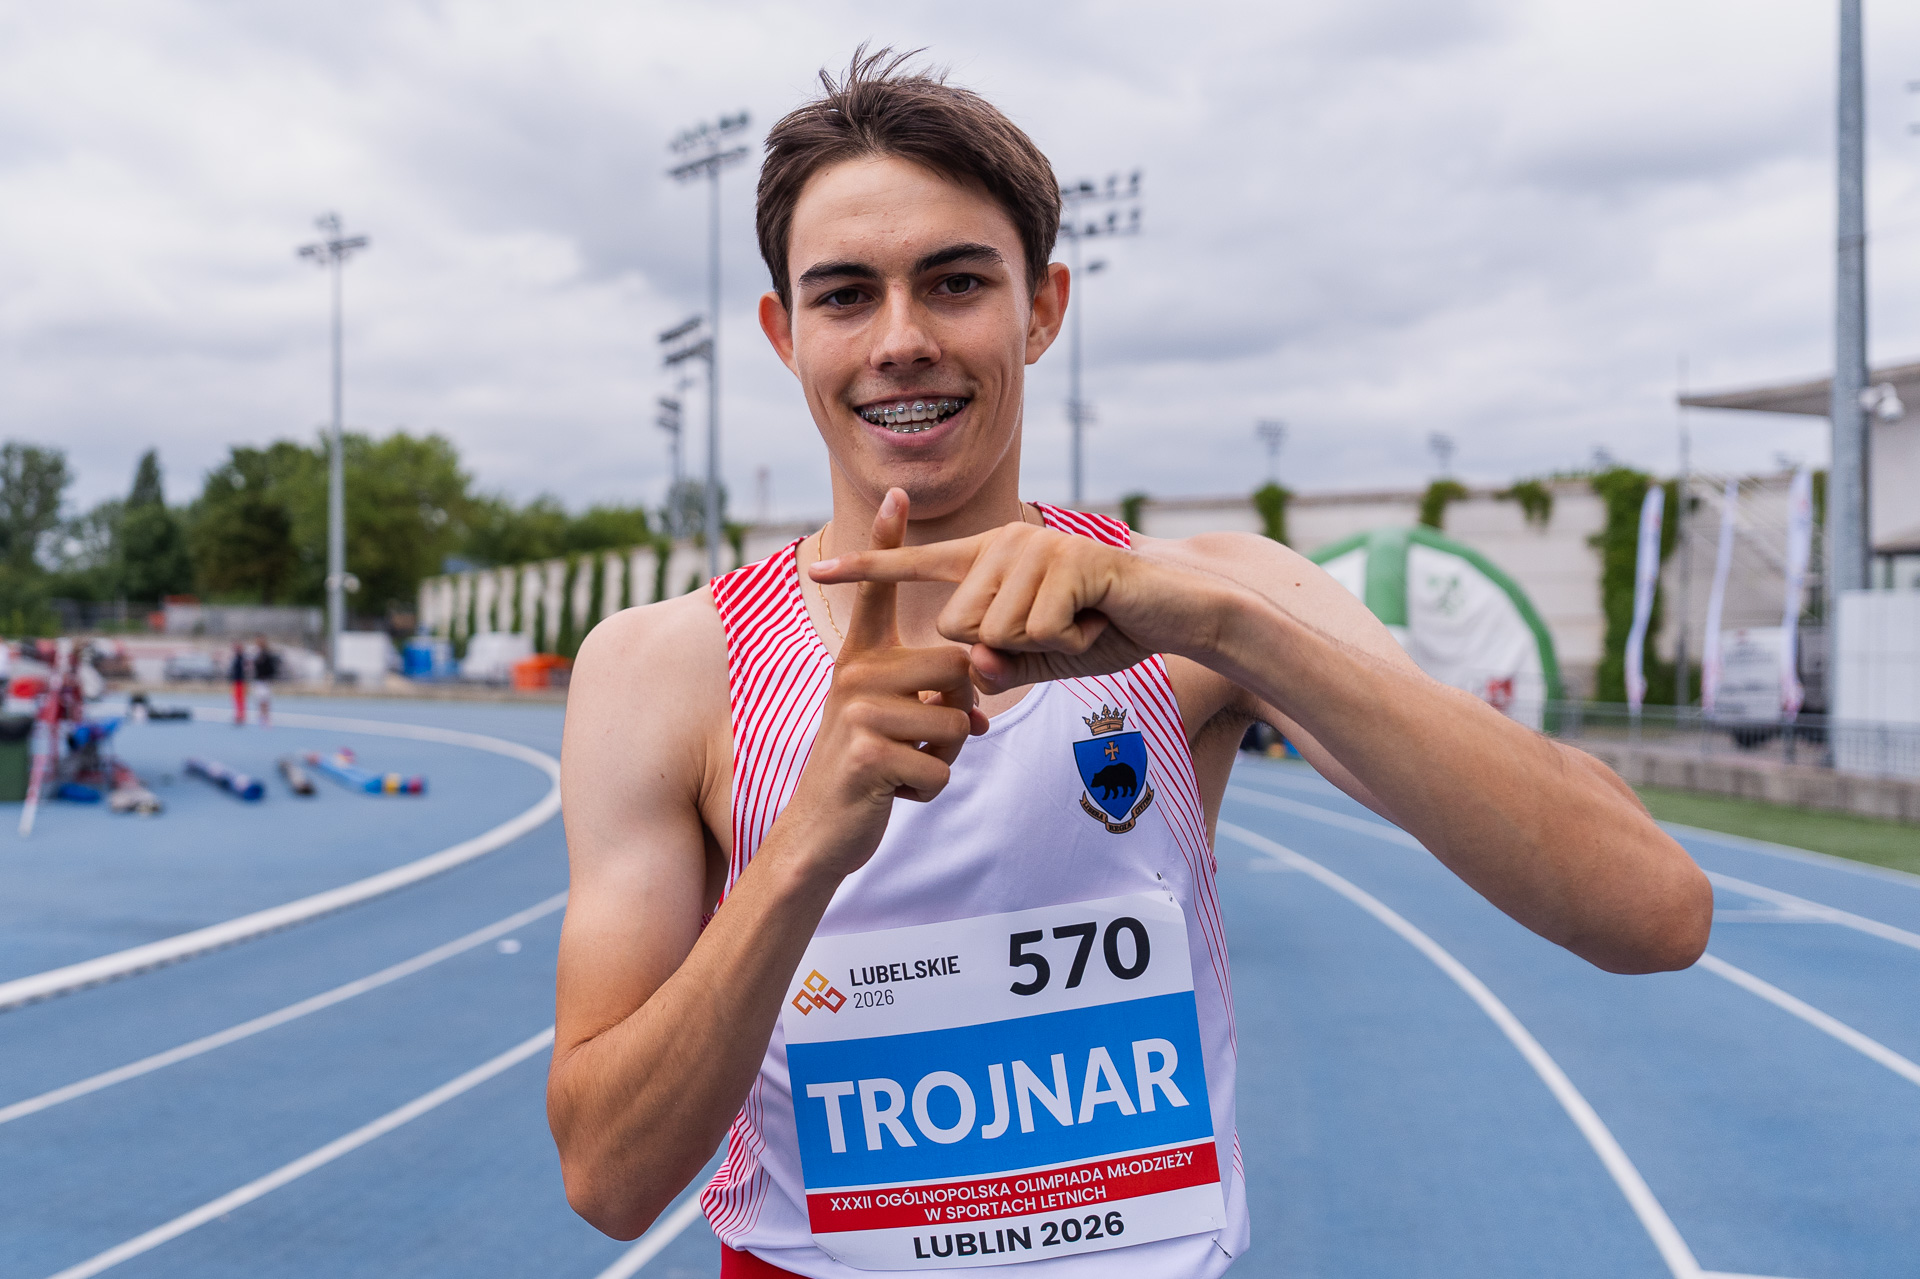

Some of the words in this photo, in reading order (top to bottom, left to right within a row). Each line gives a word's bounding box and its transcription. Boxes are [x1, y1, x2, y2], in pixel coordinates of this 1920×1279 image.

[849, 955, 961, 987] LUBELSKIE
[1008, 916, 1151, 996] 570
[853, 989, 895, 1009] 2026
[806, 1038, 1189, 1153] TROJNAR
[830, 1195, 872, 1211] XXXII
[875, 1183, 1011, 1208] OGÓLNOPOLSKA
[1015, 1167, 1104, 1194] OLIMPIADA
[1107, 1151, 1194, 1179] MŁODZIEŻY
[924, 1207, 942, 1222] W
[946, 1197, 1037, 1220] SPORTACH
[1040, 1185, 1107, 1209] LETNICH
[913, 1226, 1032, 1259] LUBLIN
[1040, 1211, 1125, 1247] 2026
